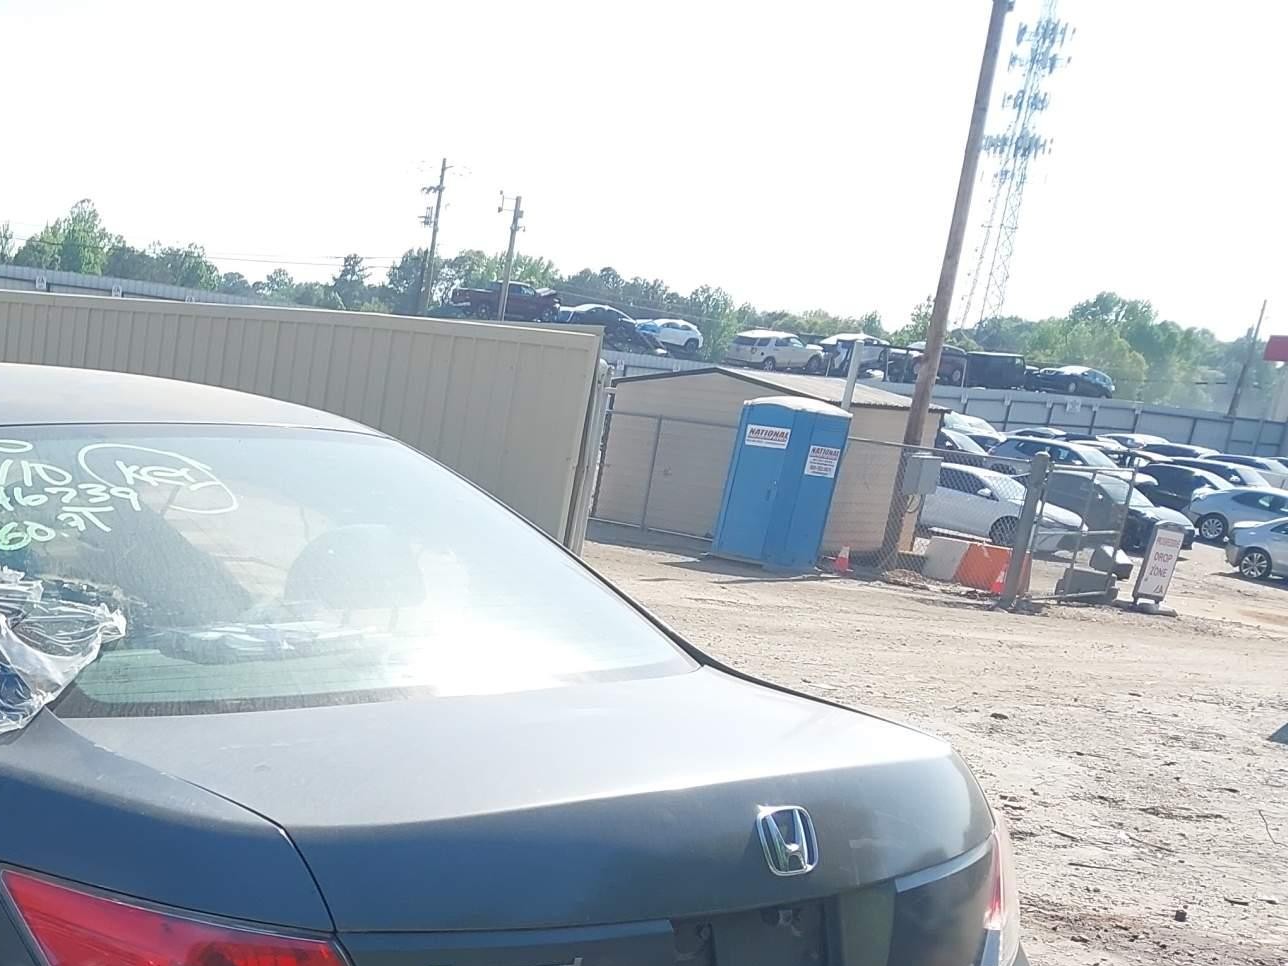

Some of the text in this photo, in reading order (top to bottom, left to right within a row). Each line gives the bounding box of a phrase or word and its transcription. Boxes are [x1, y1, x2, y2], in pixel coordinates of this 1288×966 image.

[749, 427, 789, 439] NATIONAL
[811, 447, 840, 456] NATIONAL
[1154, 551, 1173, 562] DROP
[1150, 565, 1169, 577] ZONE
